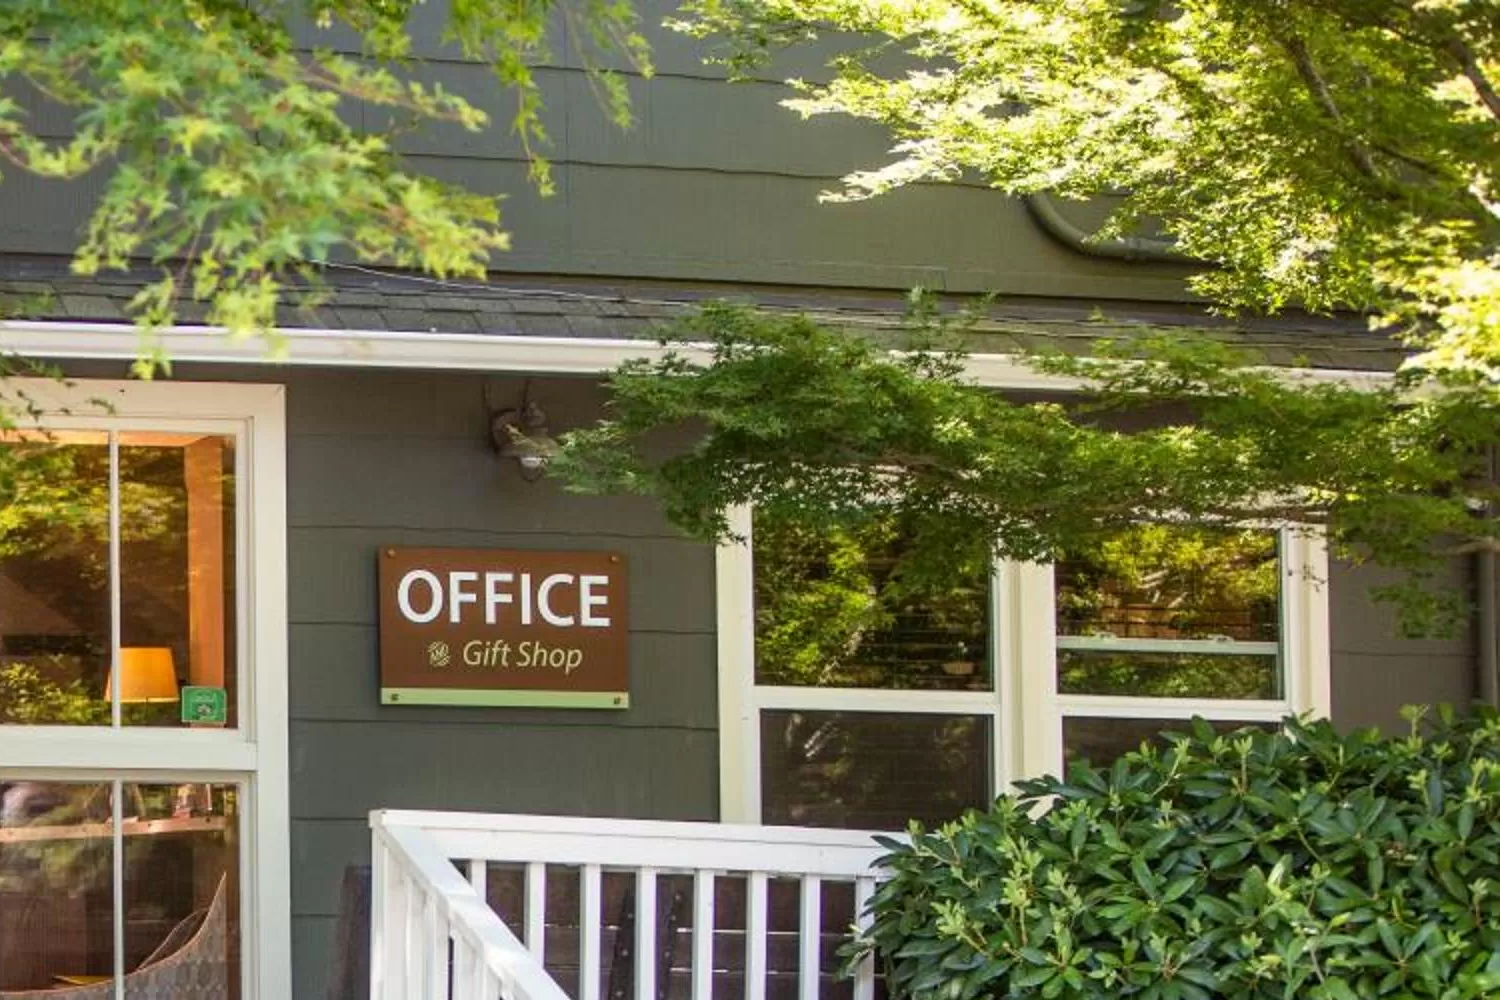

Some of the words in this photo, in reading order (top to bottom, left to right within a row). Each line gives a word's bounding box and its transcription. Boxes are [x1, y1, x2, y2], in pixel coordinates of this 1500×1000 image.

[397, 569, 611, 627] OFFICE
[462, 639, 512, 668] Gift
[516, 641, 583, 675] Shop
